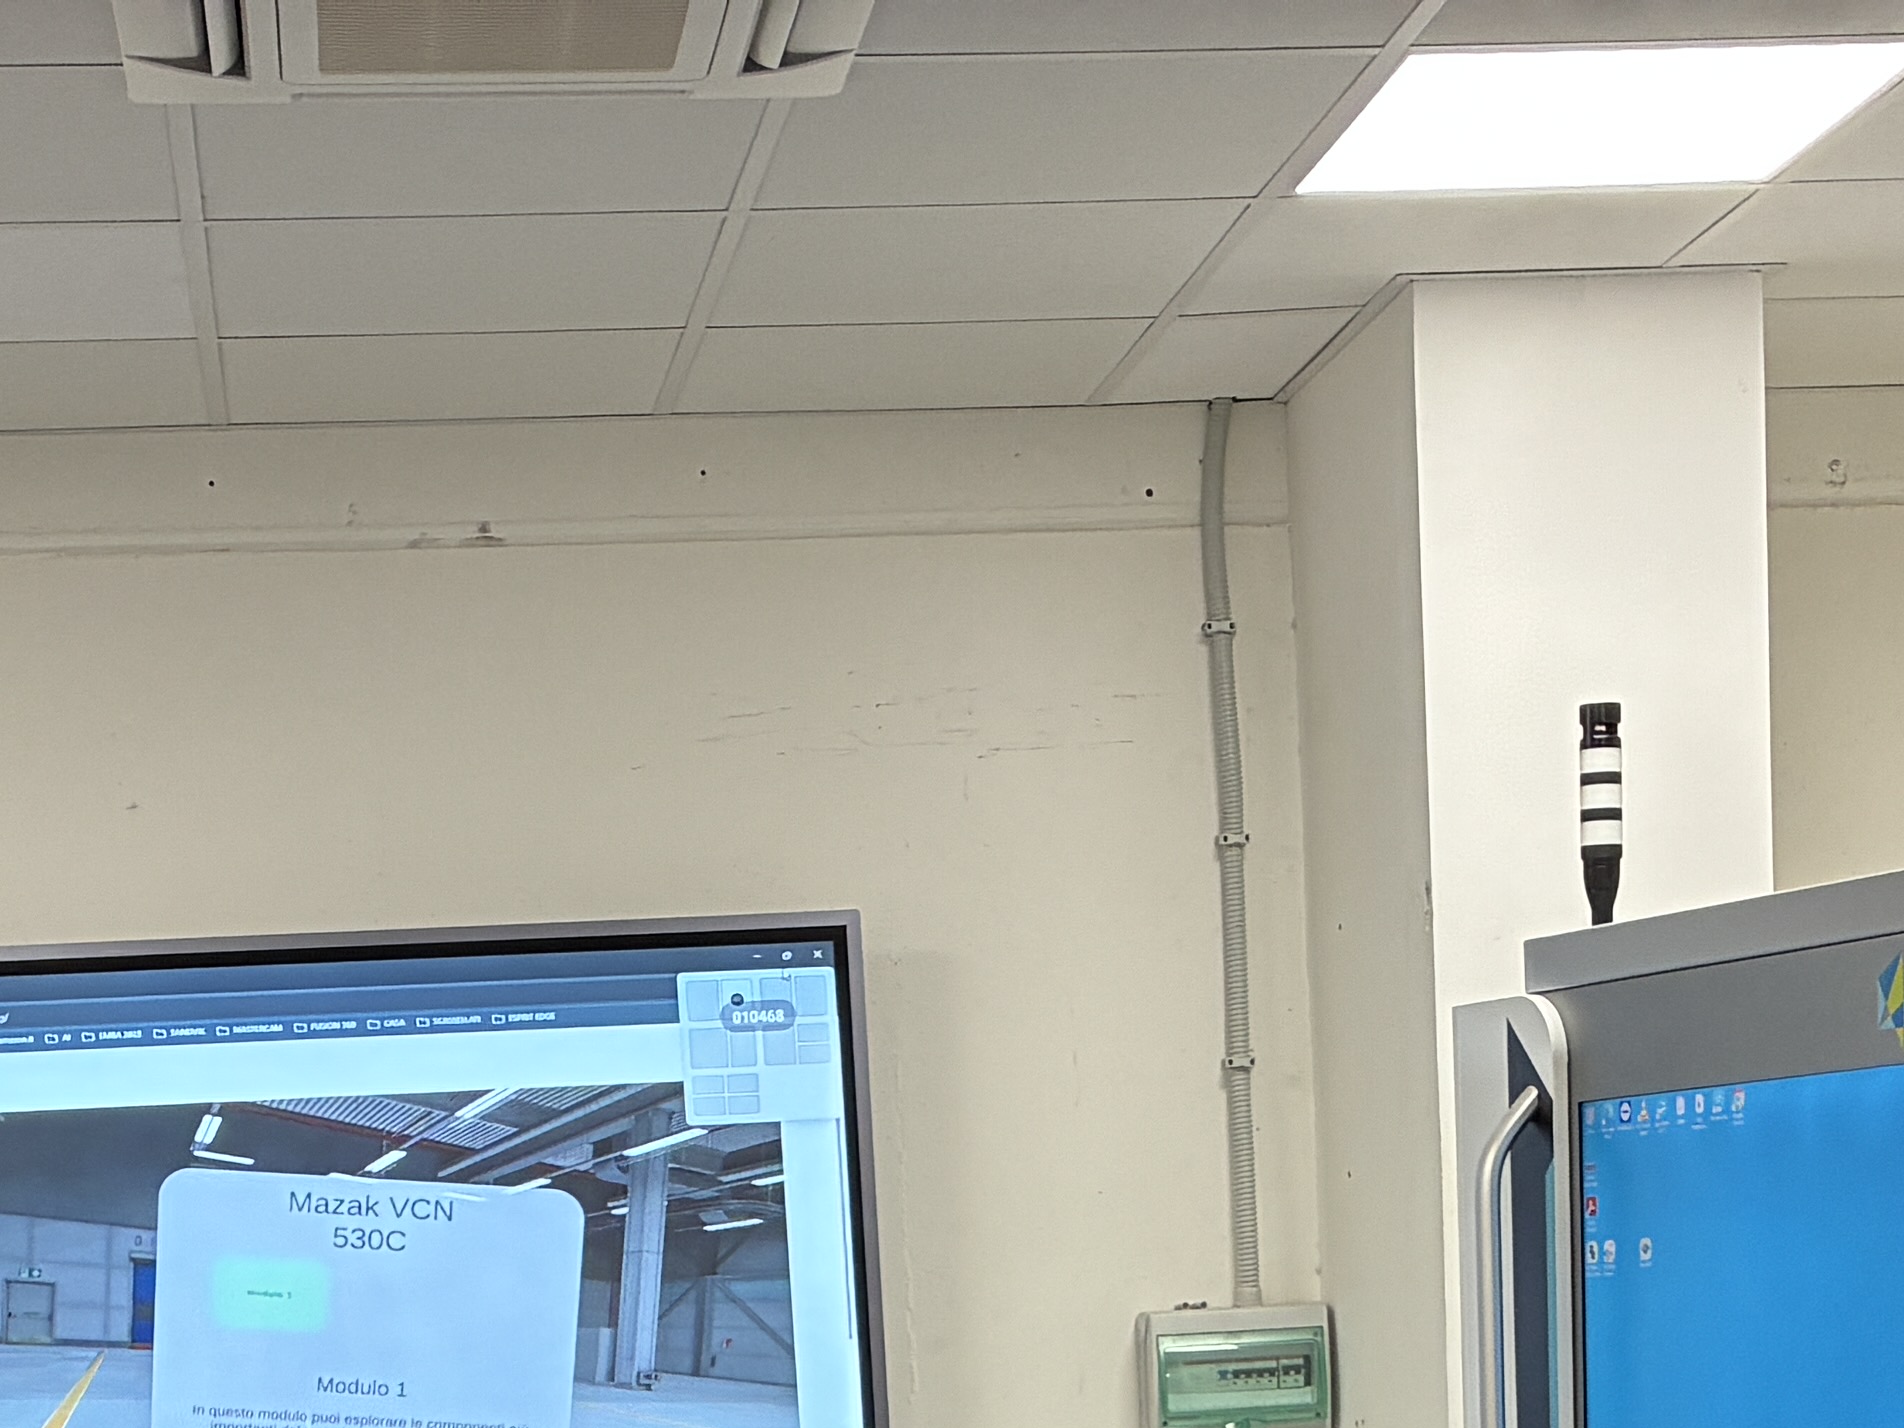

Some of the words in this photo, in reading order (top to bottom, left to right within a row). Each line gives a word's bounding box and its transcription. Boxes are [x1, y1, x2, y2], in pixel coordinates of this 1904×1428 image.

[732, 1008, 785, 1024] 010468
[289, 1190, 379, 1218] Mazak
[389, 1195, 455, 1222] VCN
[332, 1226, 407, 1252] 530C
[317, 1376, 389, 1397] Modulo
[396, 1381, 407, 1398] 1
[208, 1405, 254, 1419] questo
[257, 1408, 308, 1423] modulo
[311, 1412, 340, 1425] puoi
[345, 1415, 407, 1428] esplorare
[410, 1417, 423, 1428] le
